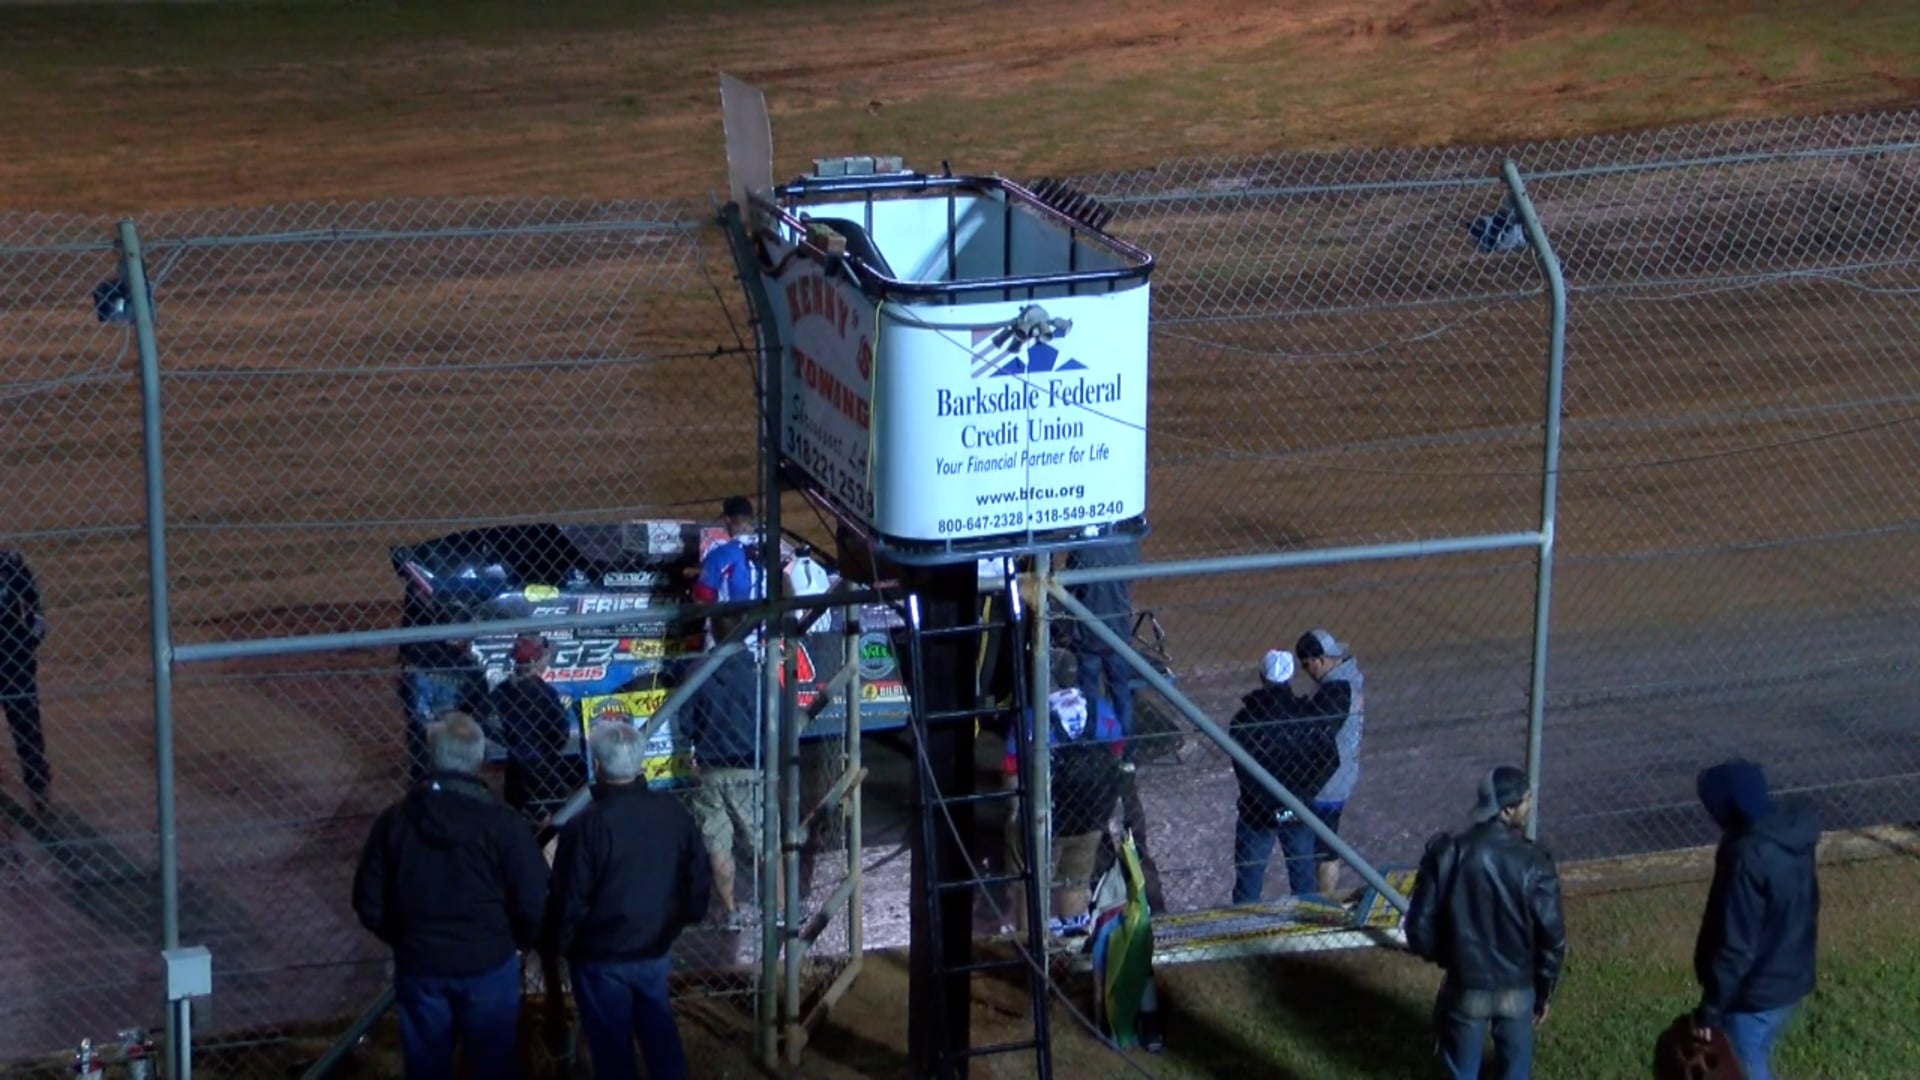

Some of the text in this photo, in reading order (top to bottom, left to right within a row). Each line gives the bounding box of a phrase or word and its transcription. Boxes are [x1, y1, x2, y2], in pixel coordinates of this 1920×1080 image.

[791, 344, 870, 431] TOWING
[936, 373, 1122, 418] Barksdale Federal
[960, 417, 1085, 449] Credit Union
[848, 441, 867, 476] LA
[935, 443, 1110, 476] Your Financial Partner for Life
[975, 484, 1086, 506] www.bfcu.org
[937, 500, 1125, 534] 800-647-2328 318-549-8240
